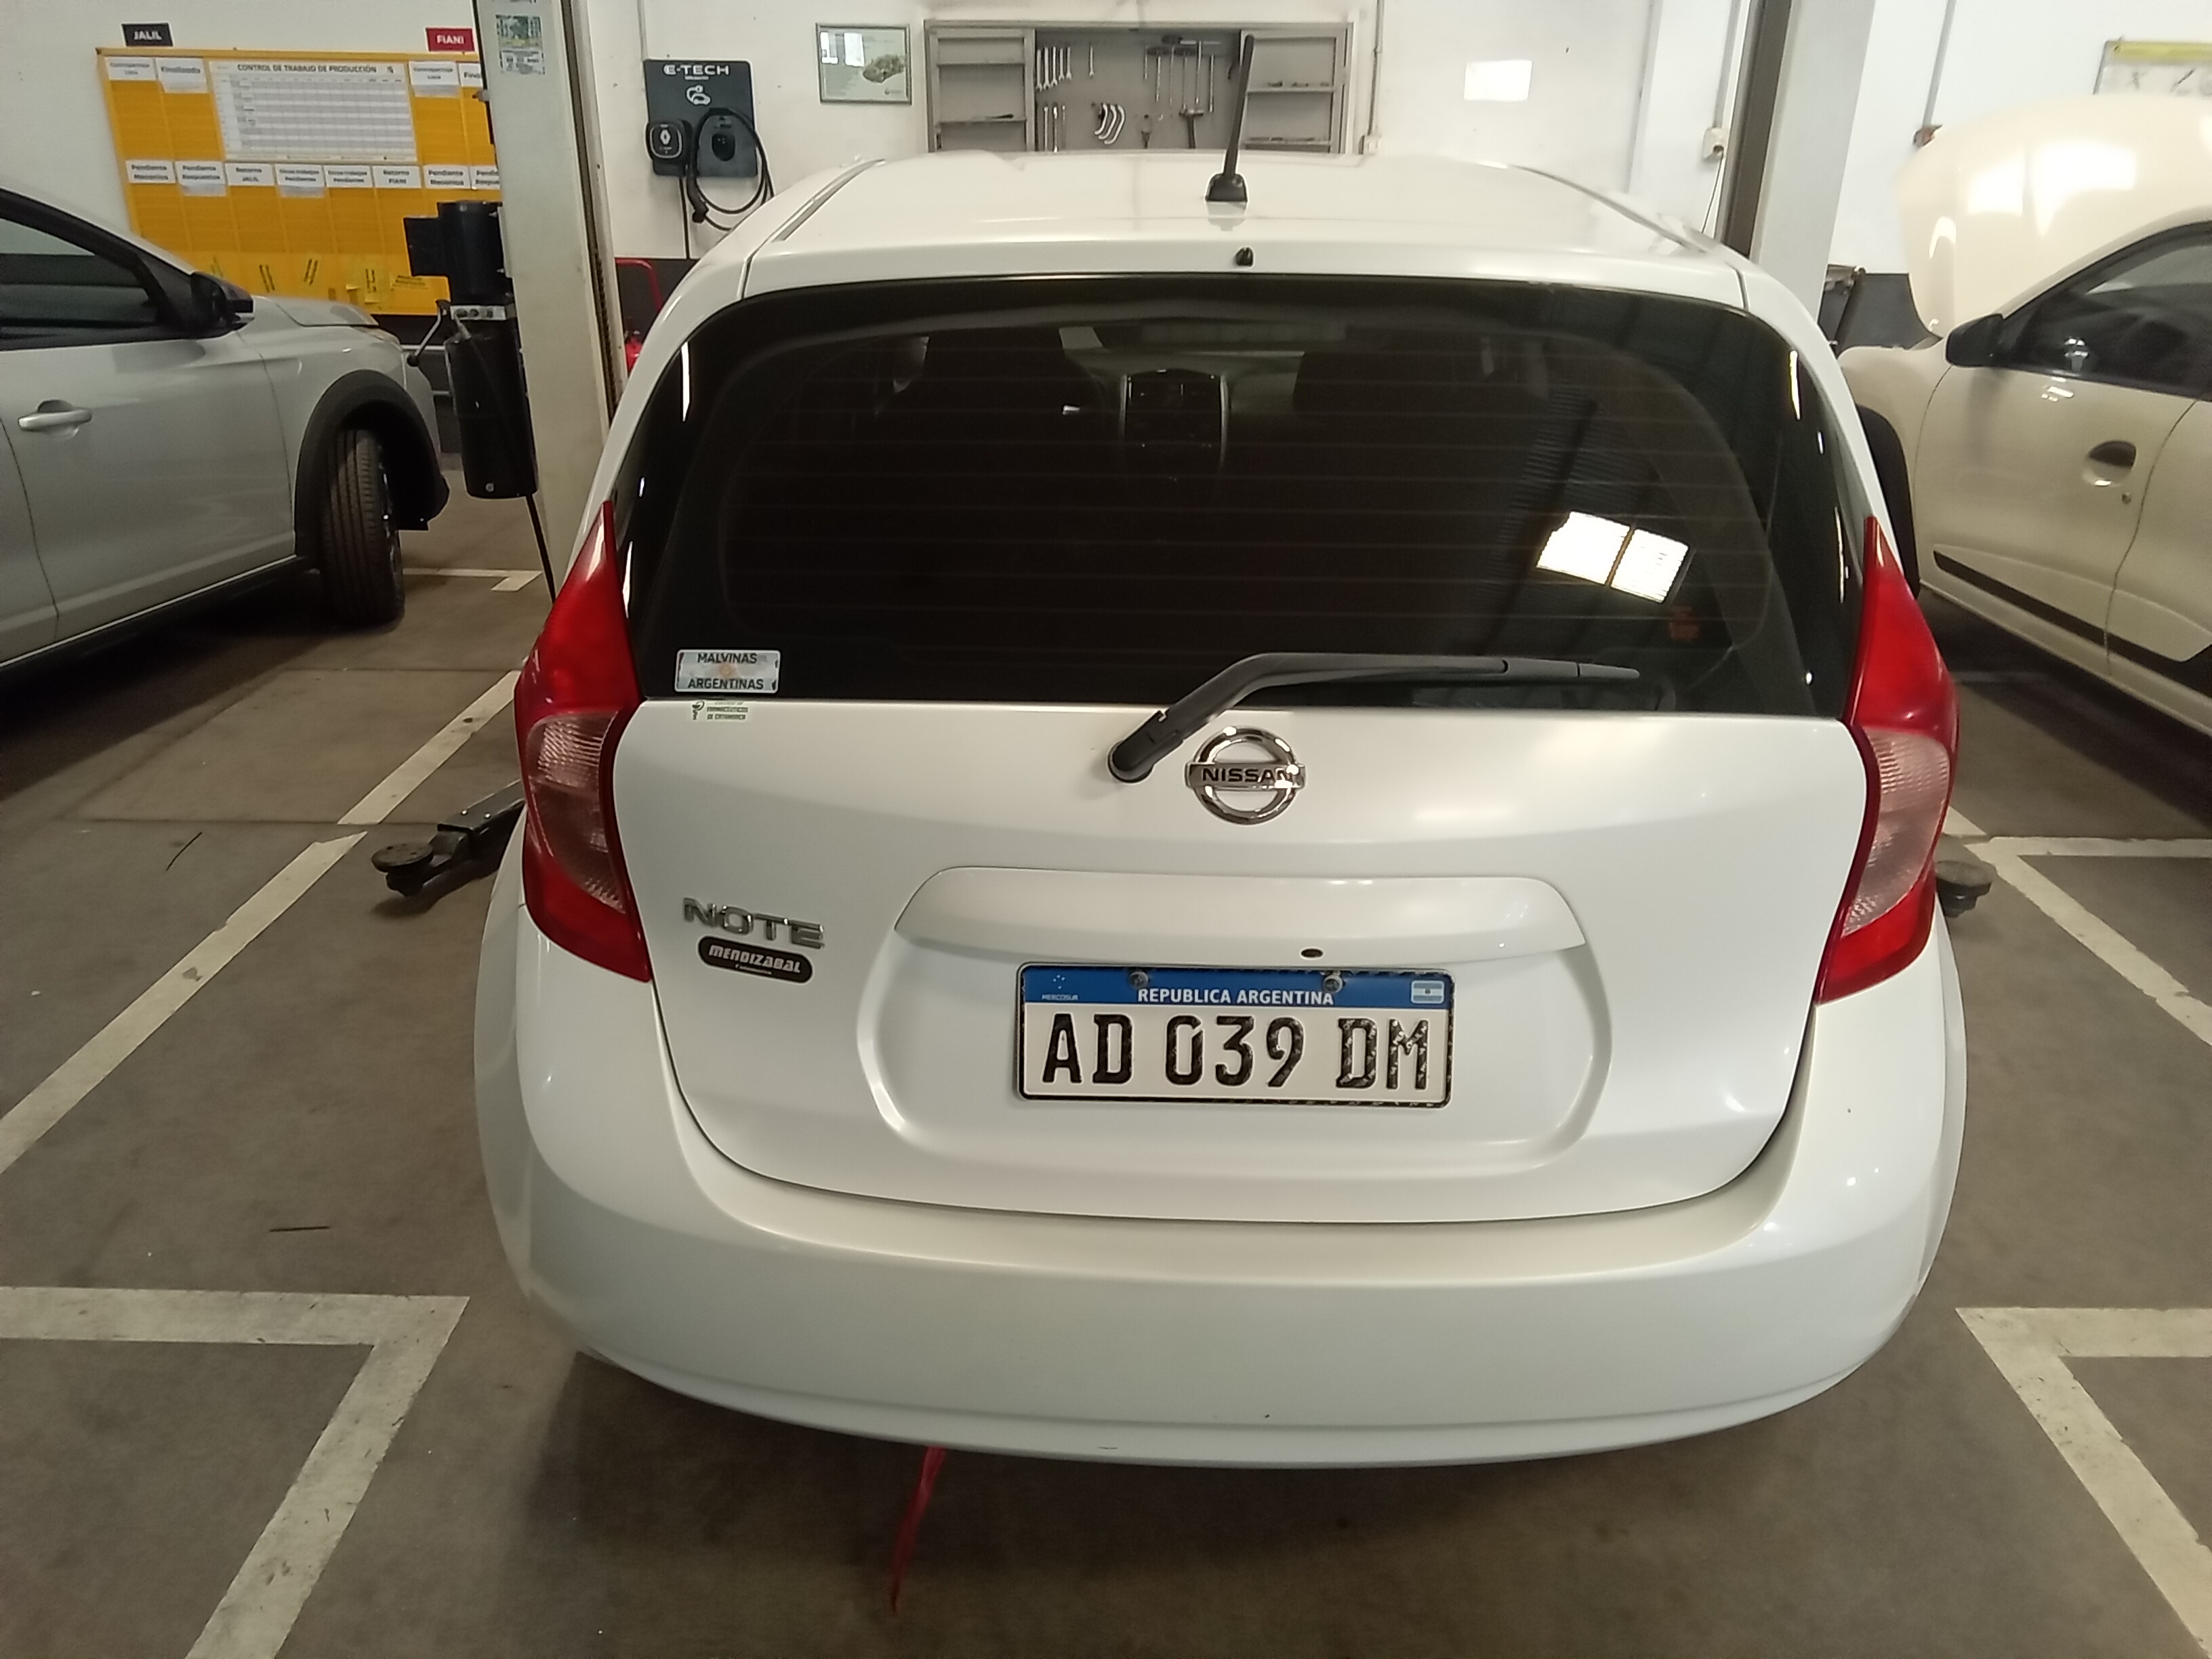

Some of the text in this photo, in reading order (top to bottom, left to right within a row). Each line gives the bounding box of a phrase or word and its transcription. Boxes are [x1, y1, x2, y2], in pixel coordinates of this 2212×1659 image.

[436, 35, 464, 44] FIANI
[663, 64, 730, 75] E-TECH
[697, 653, 758, 664] MALVINAS
[687, 678, 764, 690] ARGENTINAS
[1202, 767, 1293, 784] NISSAN
[682, 897, 825, 949] NOTE
[708, 944, 802, 974] MENDIZABAL
[1137, 988, 1334, 1006] REPUBLICA ARGENTINA
[1041, 1013, 1429, 1090] AD 039 DM
